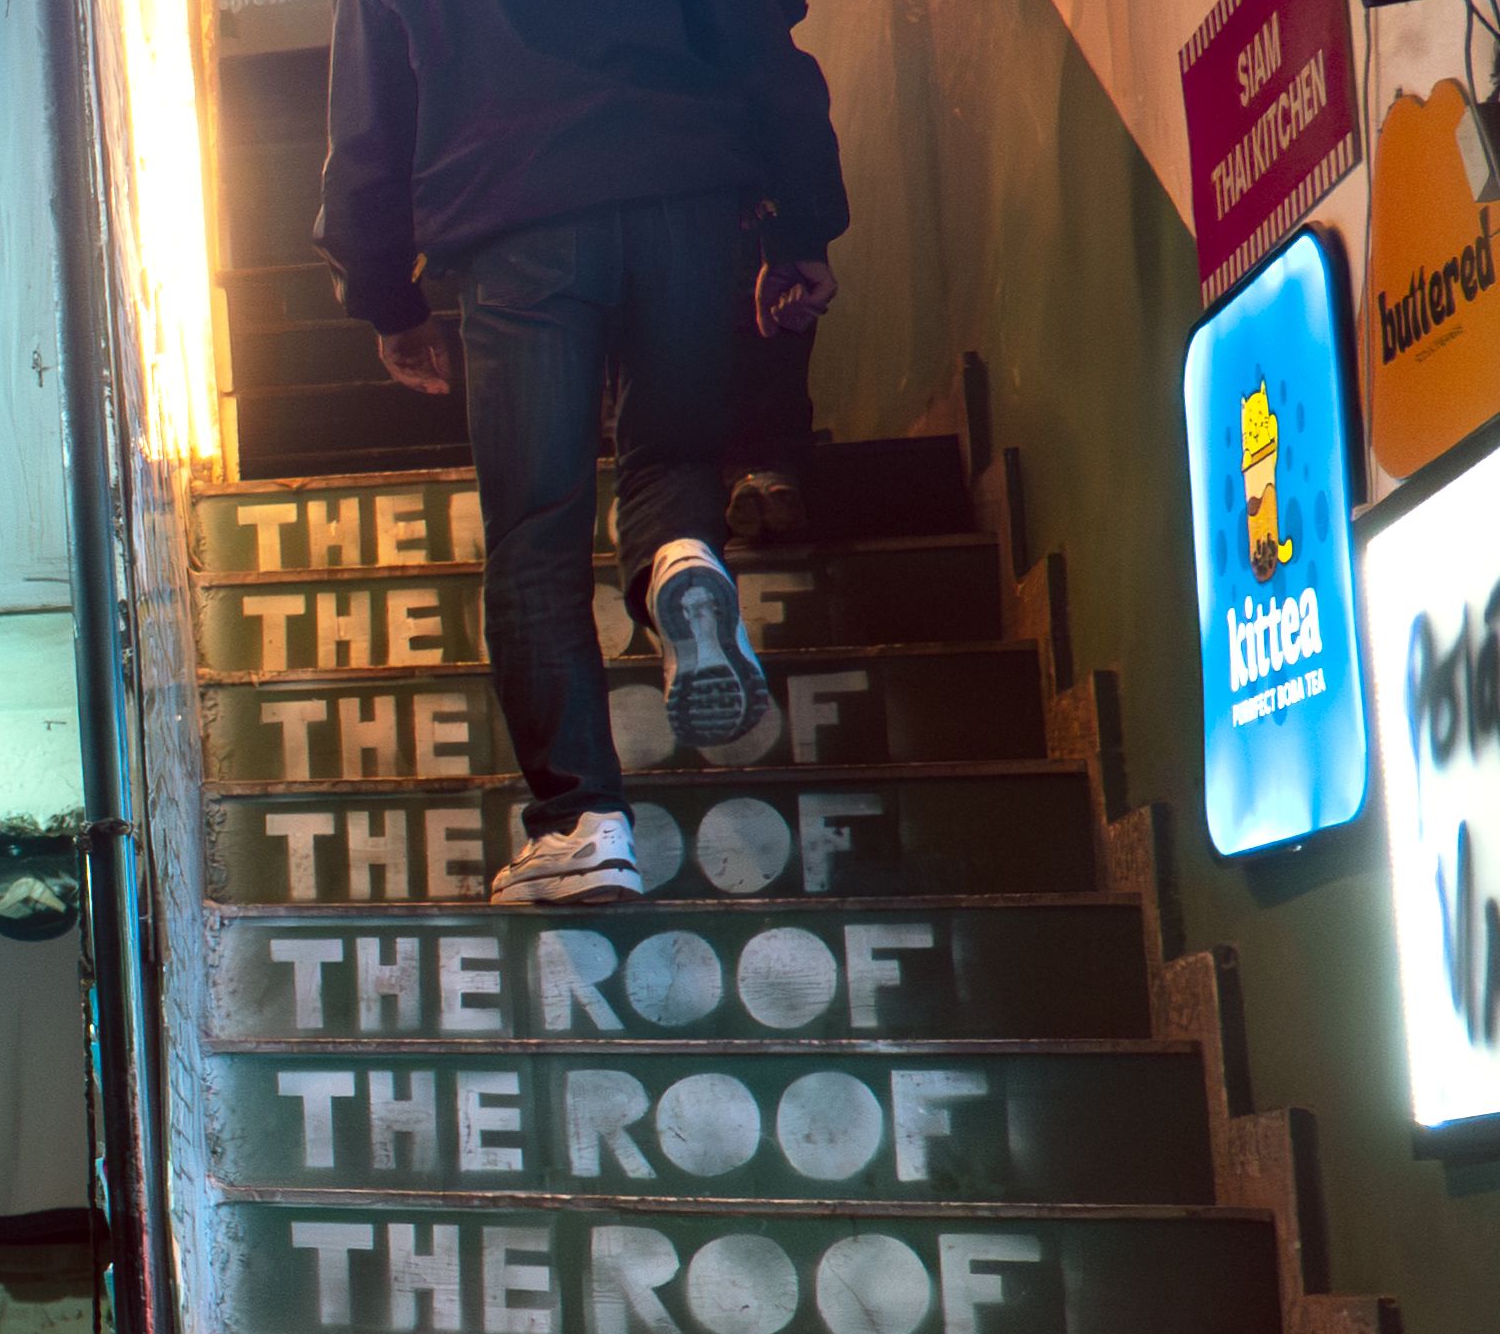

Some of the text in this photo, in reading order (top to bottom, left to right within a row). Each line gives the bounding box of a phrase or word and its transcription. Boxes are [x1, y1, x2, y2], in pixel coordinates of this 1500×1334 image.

[1237, 10, 1282, 109] SIAM
[1210, 47, 1328, 222] THAI KITCHEN
[1377, 204, 1496, 367] buttered
[237, 492, 430, 572] THE
[242, 589, 445, 673] THE
[1226, 586, 1323, 693] kittea
[1304, 667, 1327, 698] TEA
[260, 692, 471, 782] THE
[264, 807, 484, 901] THE
[270, 922, 935, 1033] THE ROOF
[276, 1068, 988, 1182] THE ROOF
